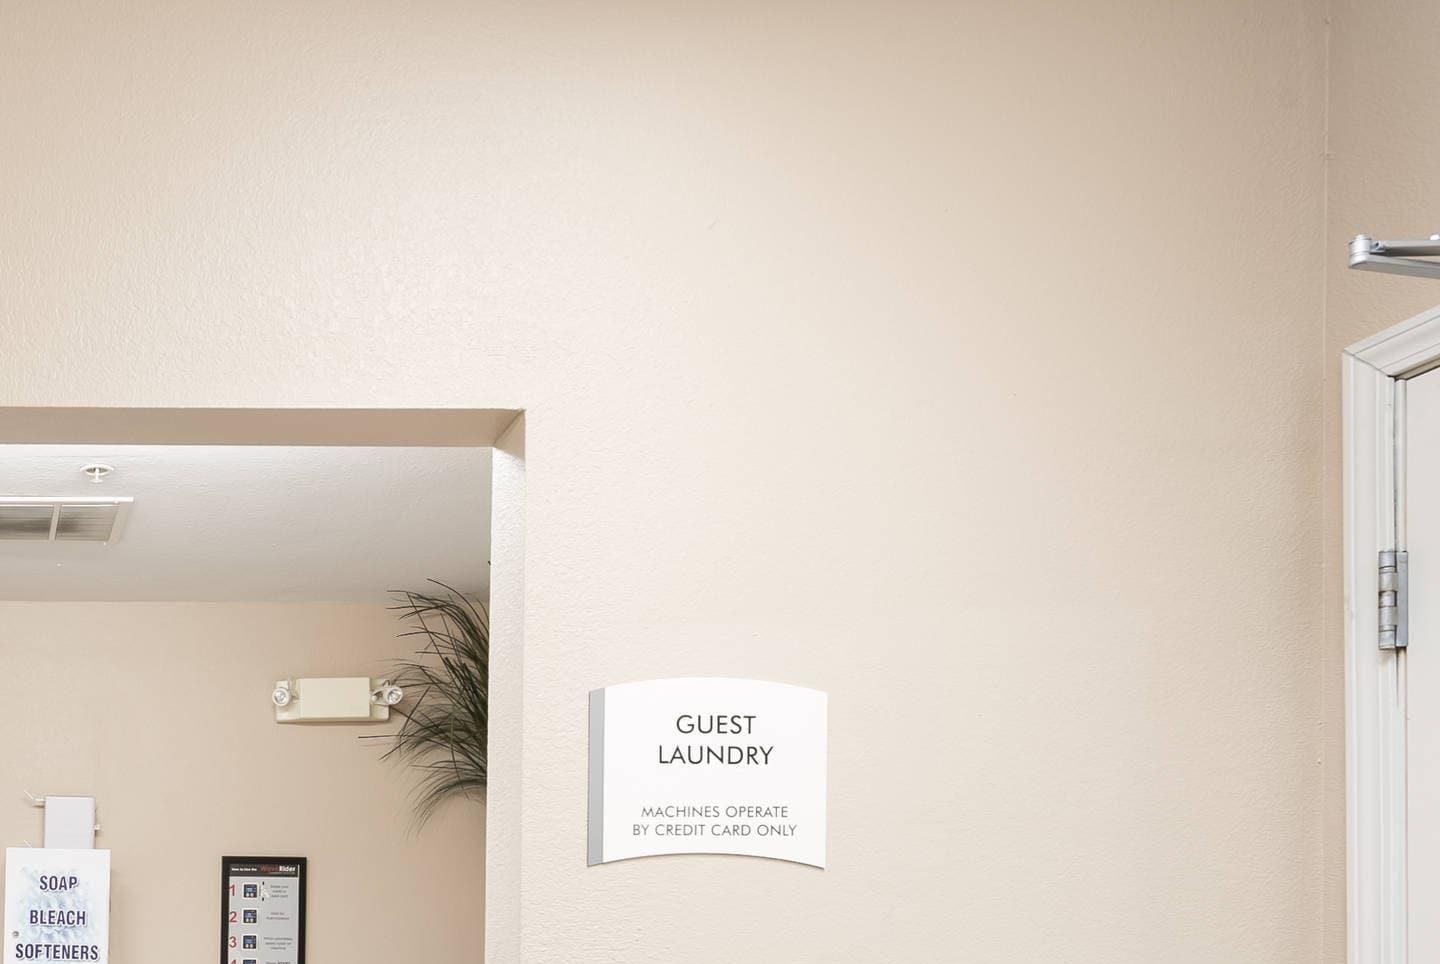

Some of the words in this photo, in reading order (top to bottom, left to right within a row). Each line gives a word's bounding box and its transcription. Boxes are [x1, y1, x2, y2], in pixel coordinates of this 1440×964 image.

[676, 714, 757, 735] GUEST
[658, 744, 774, 765] LAUNDRY
[641, 805, 720, 818] MACHINES
[725, 805, 788, 818] OPERATE
[632, 824, 649, 836] BY
[655, 824, 706, 836] CREDIT
[711, 824, 751, 836] CARD
[757, 824, 797, 837] ONLY
[39, 875, 79, 892] SOAP
[229, 884, 235, 896] 1
[29, 909, 87, 928] BLEACH
[229, 911, 238, 923] 2
[229, 936, 237, 948] 3
[15, 943, 99, 961] SOFTENERS
